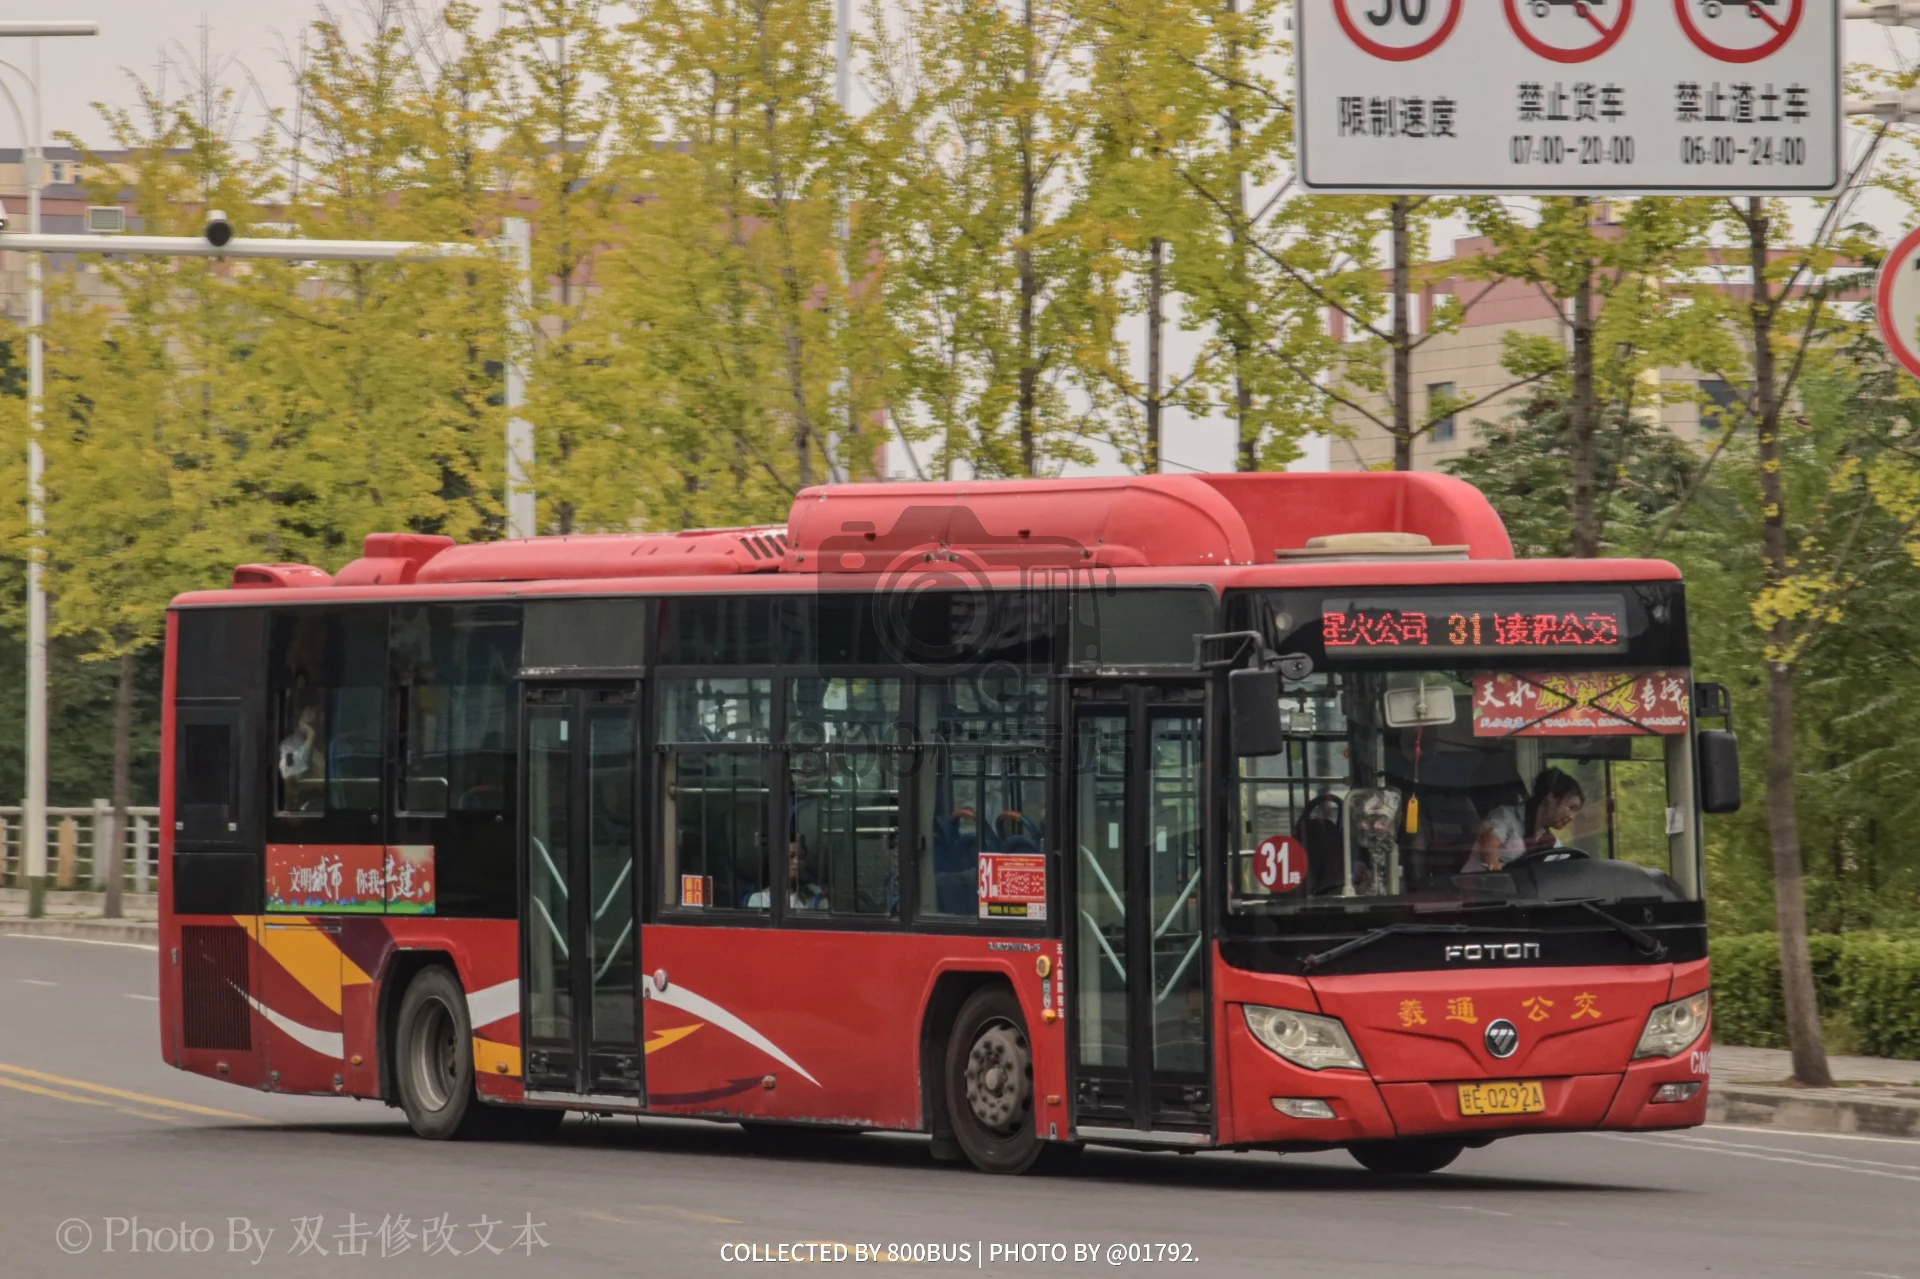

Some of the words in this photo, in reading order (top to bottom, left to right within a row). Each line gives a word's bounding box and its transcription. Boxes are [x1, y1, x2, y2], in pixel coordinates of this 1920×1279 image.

[1337, 97, 1457, 137] 限制速度
[1517, 82, 1625, 122] 禁止货车
[1675, 82, 1809, 122] 禁止渣土车
[1510, 135, 1634, 165] 07:00-20:00
[1681, 136, 1806, 165] 06:00-24:00
[1449, 613, 1481, 645] 31
[289, 854, 343, 900] 文明城市
[1445, 943, 1540, 961] FOTON
